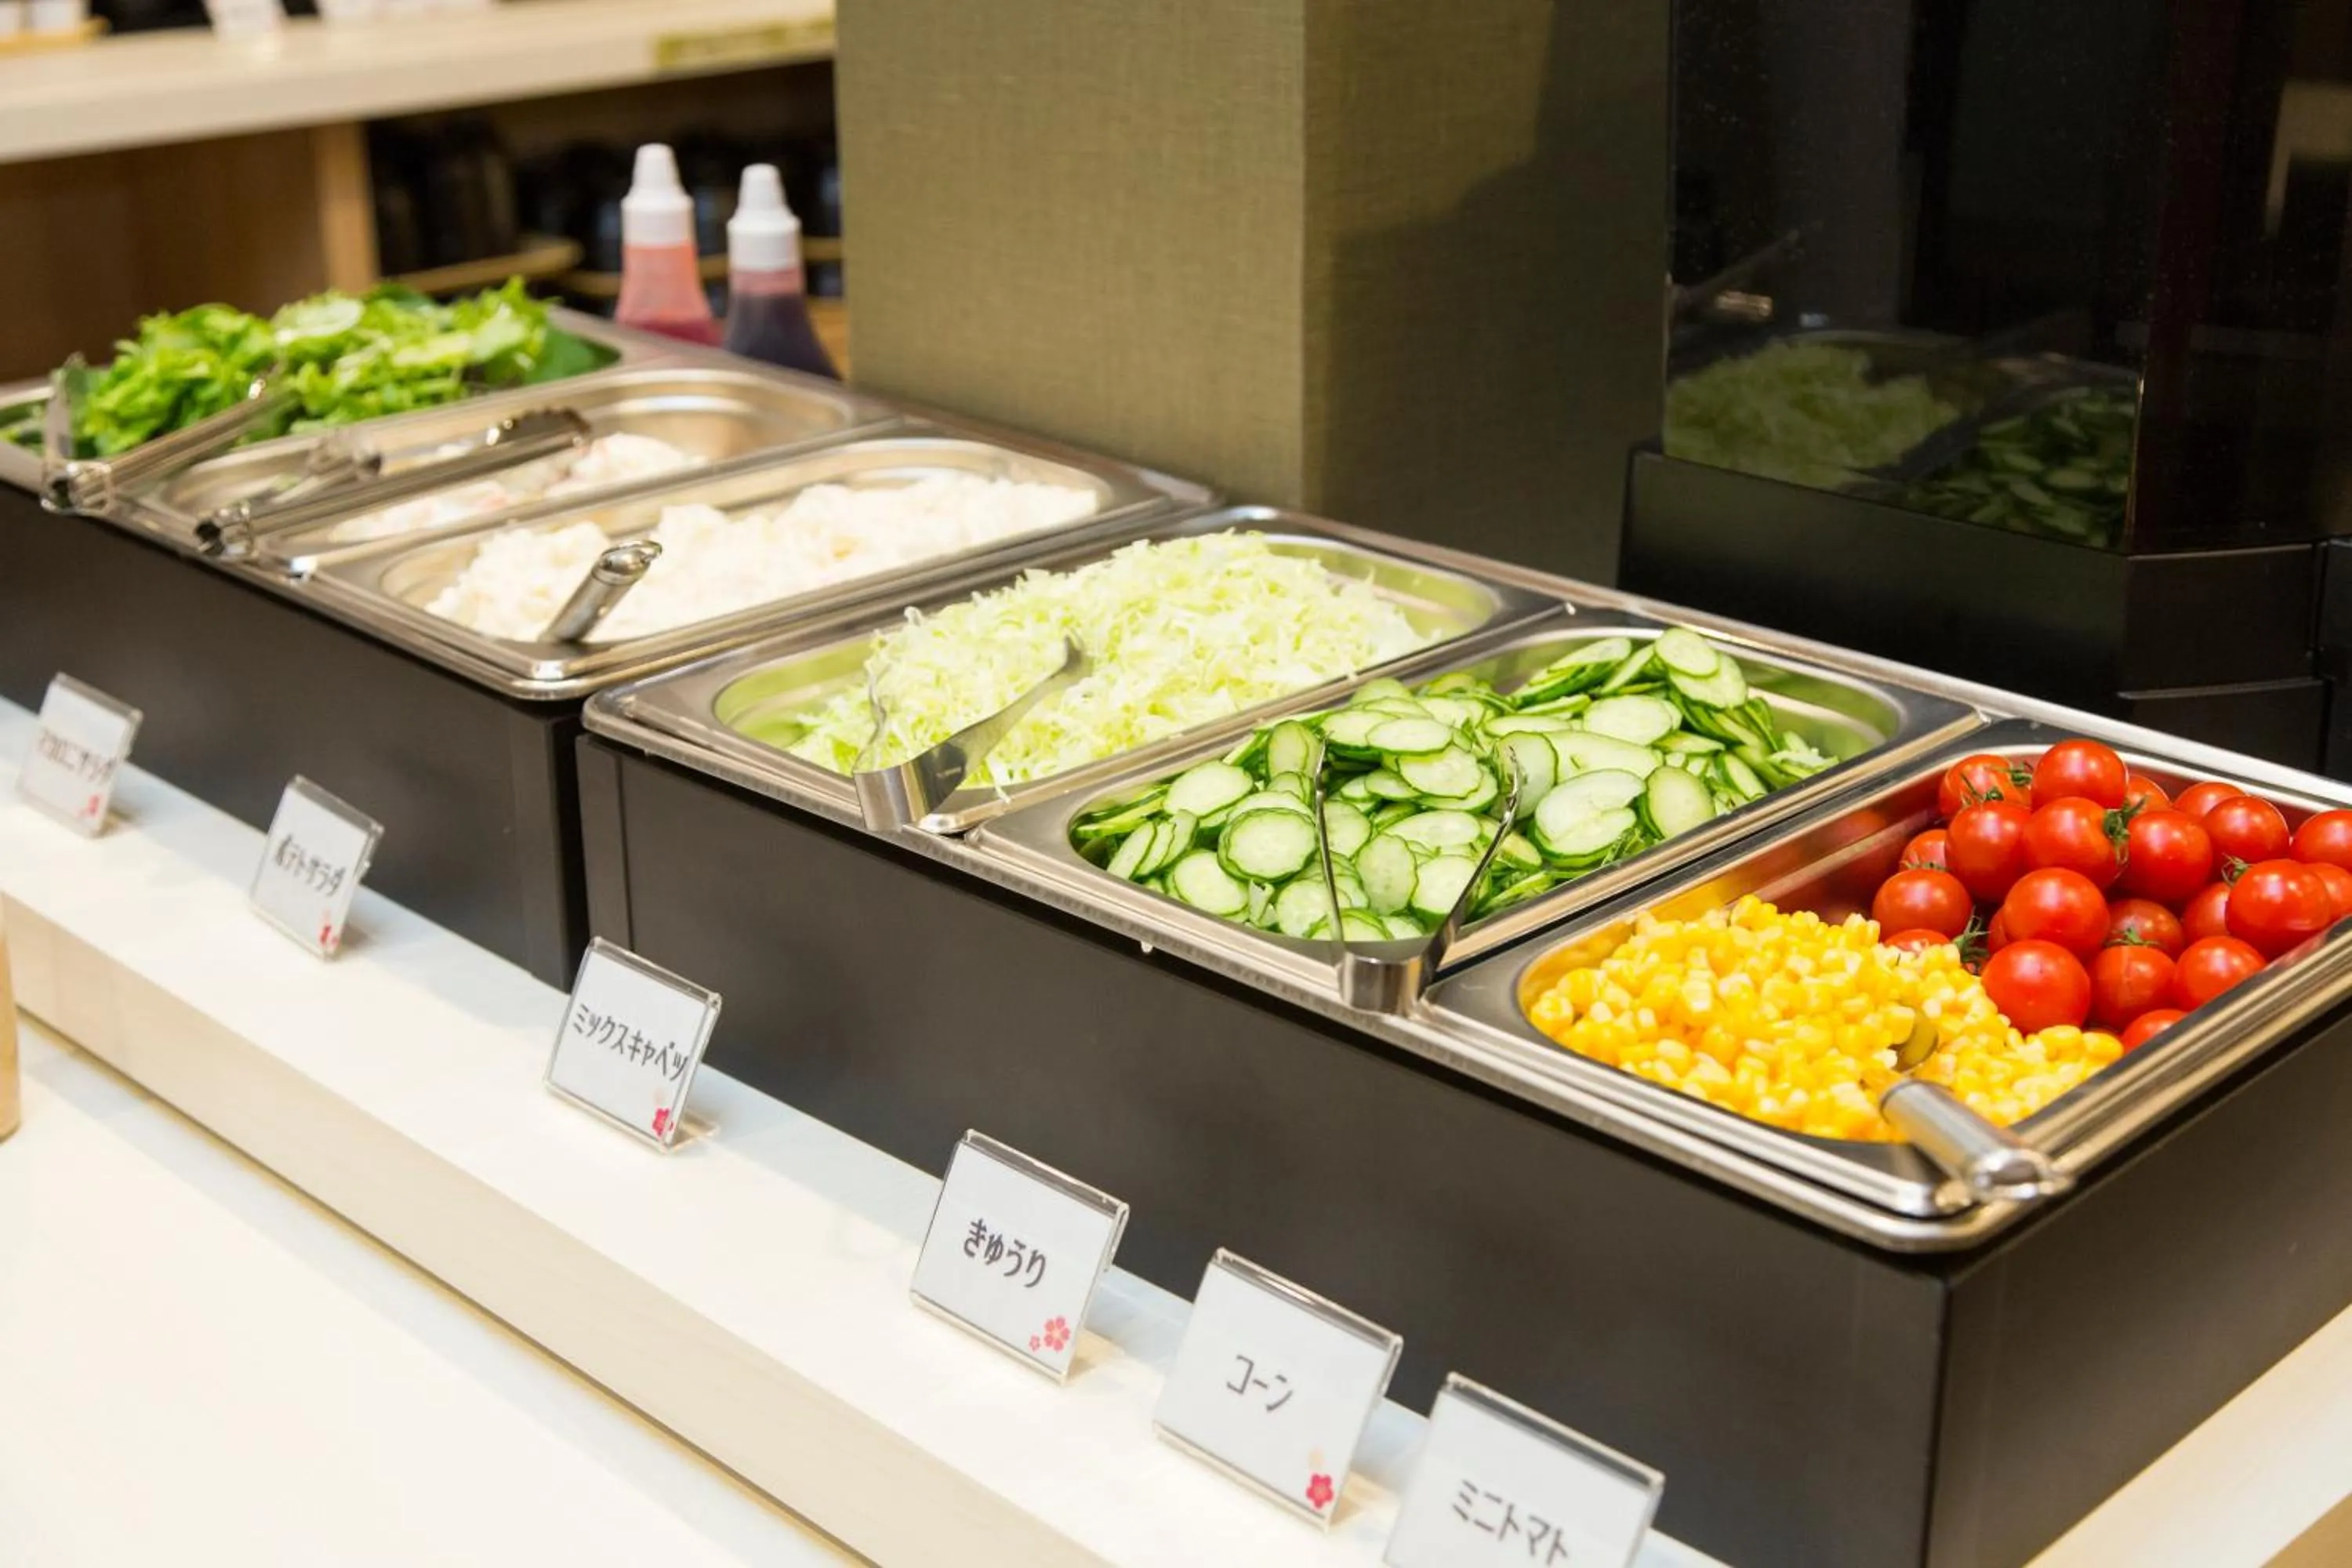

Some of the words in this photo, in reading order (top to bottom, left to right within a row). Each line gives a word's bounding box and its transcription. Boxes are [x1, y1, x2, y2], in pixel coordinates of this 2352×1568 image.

[275, 833, 346, 897] ポテトサラダ
[572, 1003, 688, 1081] ミックスキャベツ
[963, 1218, 1047, 1288] きゅうり
[1226, 1354, 1293, 1413] コーン
[1452, 1479, 1568, 1566] ミニトマト
